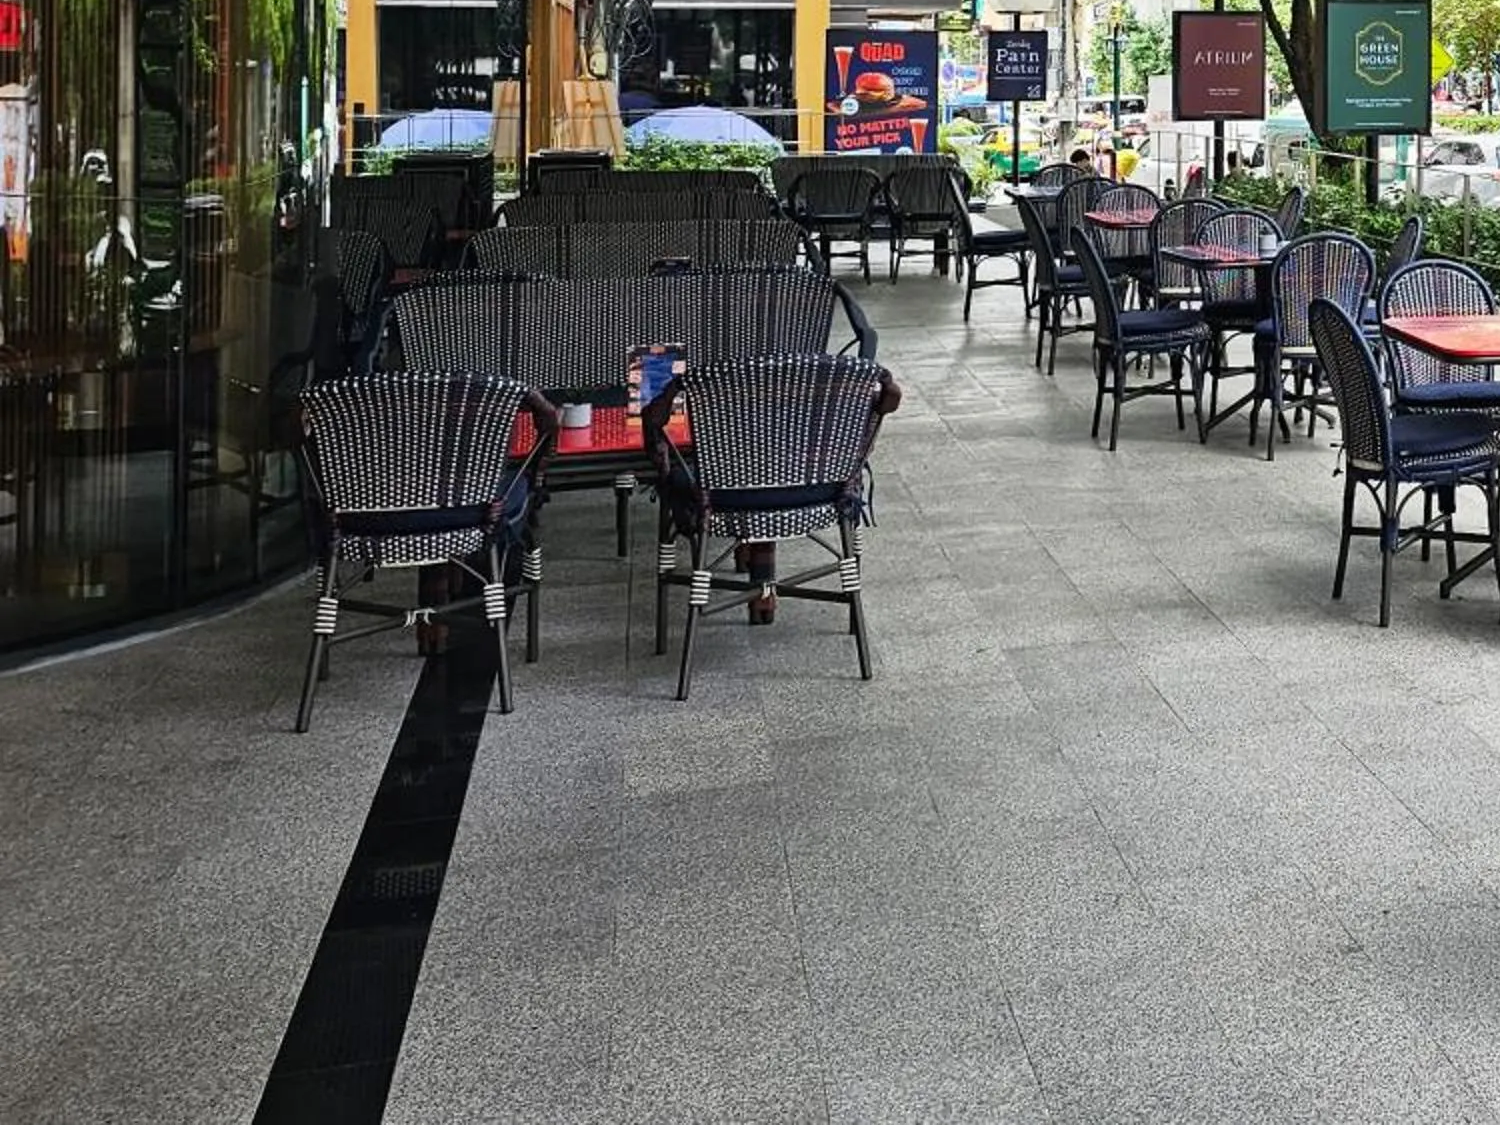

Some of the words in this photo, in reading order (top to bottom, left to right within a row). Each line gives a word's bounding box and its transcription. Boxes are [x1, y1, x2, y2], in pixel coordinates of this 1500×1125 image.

[861, 42, 905, 62] QUAD
[1360, 43, 1399, 53] GREEN
[996, 48, 1039, 62] Pain
[1194, 50, 1253, 65] ATRIUM
[1360, 55, 1399, 65] HOUSE
[995, 63, 1039, 74] Center
[837, 124, 857, 136] NO
[834, 136, 869, 149] YOUR
[872, 132, 901, 145] PICK
